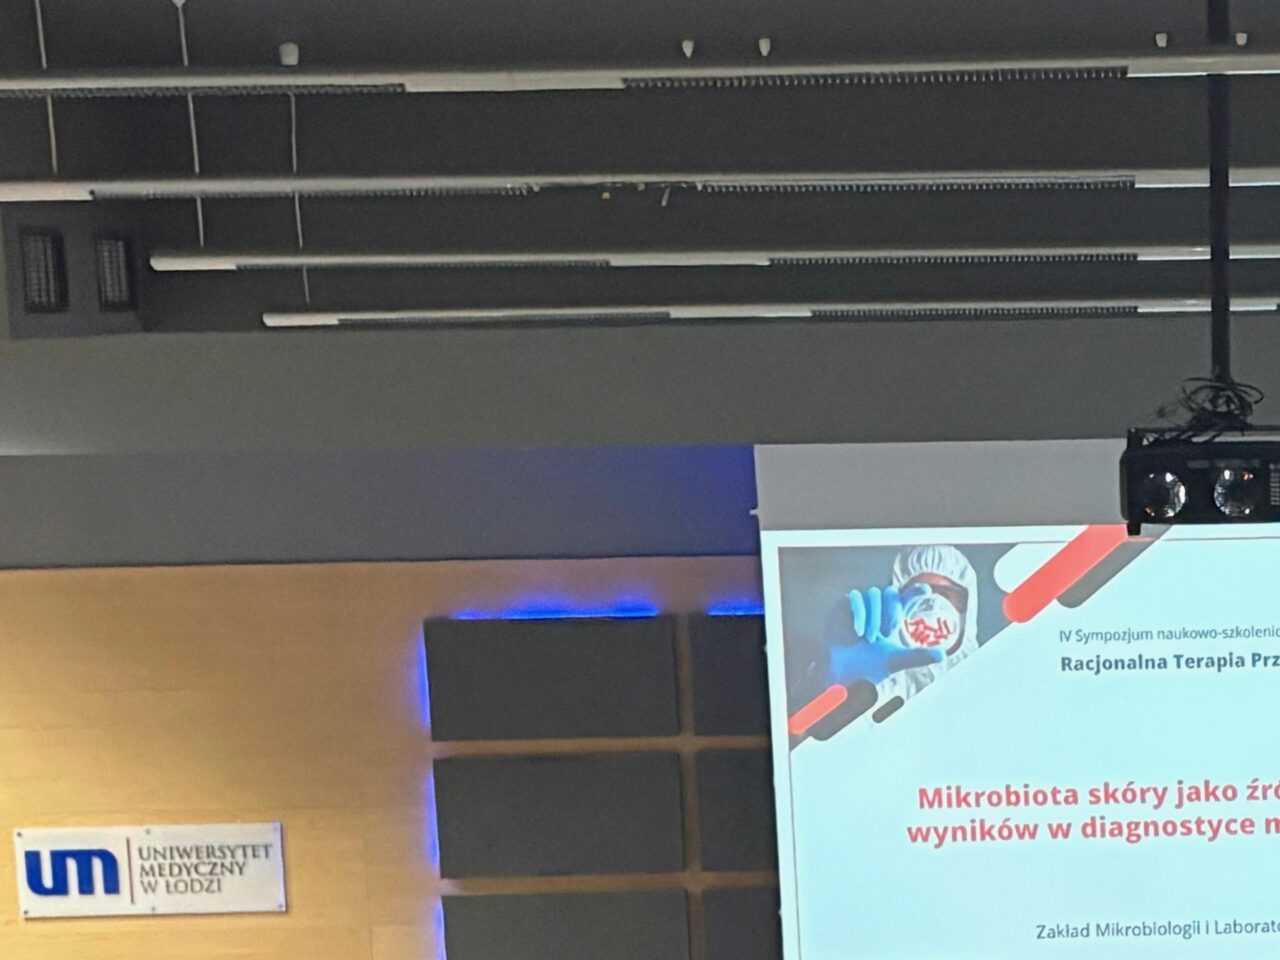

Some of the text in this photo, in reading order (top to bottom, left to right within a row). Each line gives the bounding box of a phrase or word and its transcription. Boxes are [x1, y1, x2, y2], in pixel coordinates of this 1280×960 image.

[1059, 630, 1072, 643] IV
[1075, 627, 1154, 646] Sympozjum
[1061, 653, 1168, 676] Racjonalna
[1173, 651, 1246, 673] Terapia
[918, 783, 1079, 809] Mikrobiota
[1088, 781, 1169, 810] skóry
[1175, 779, 1238, 809] jako
[907, 817, 1039, 849] wyników
[1047, 822, 1073, 840] w
[1081, 815, 1256, 844] diagnostyce
[138, 843, 273, 862] UNIWERSYTET
[139, 861, 247, 877] MEDYCZNY
[141, 879, 160, 895] W
[1036, 922, 1090, 940] Zakład
[1096, 920, 1201, 940] Mikrobiologii
